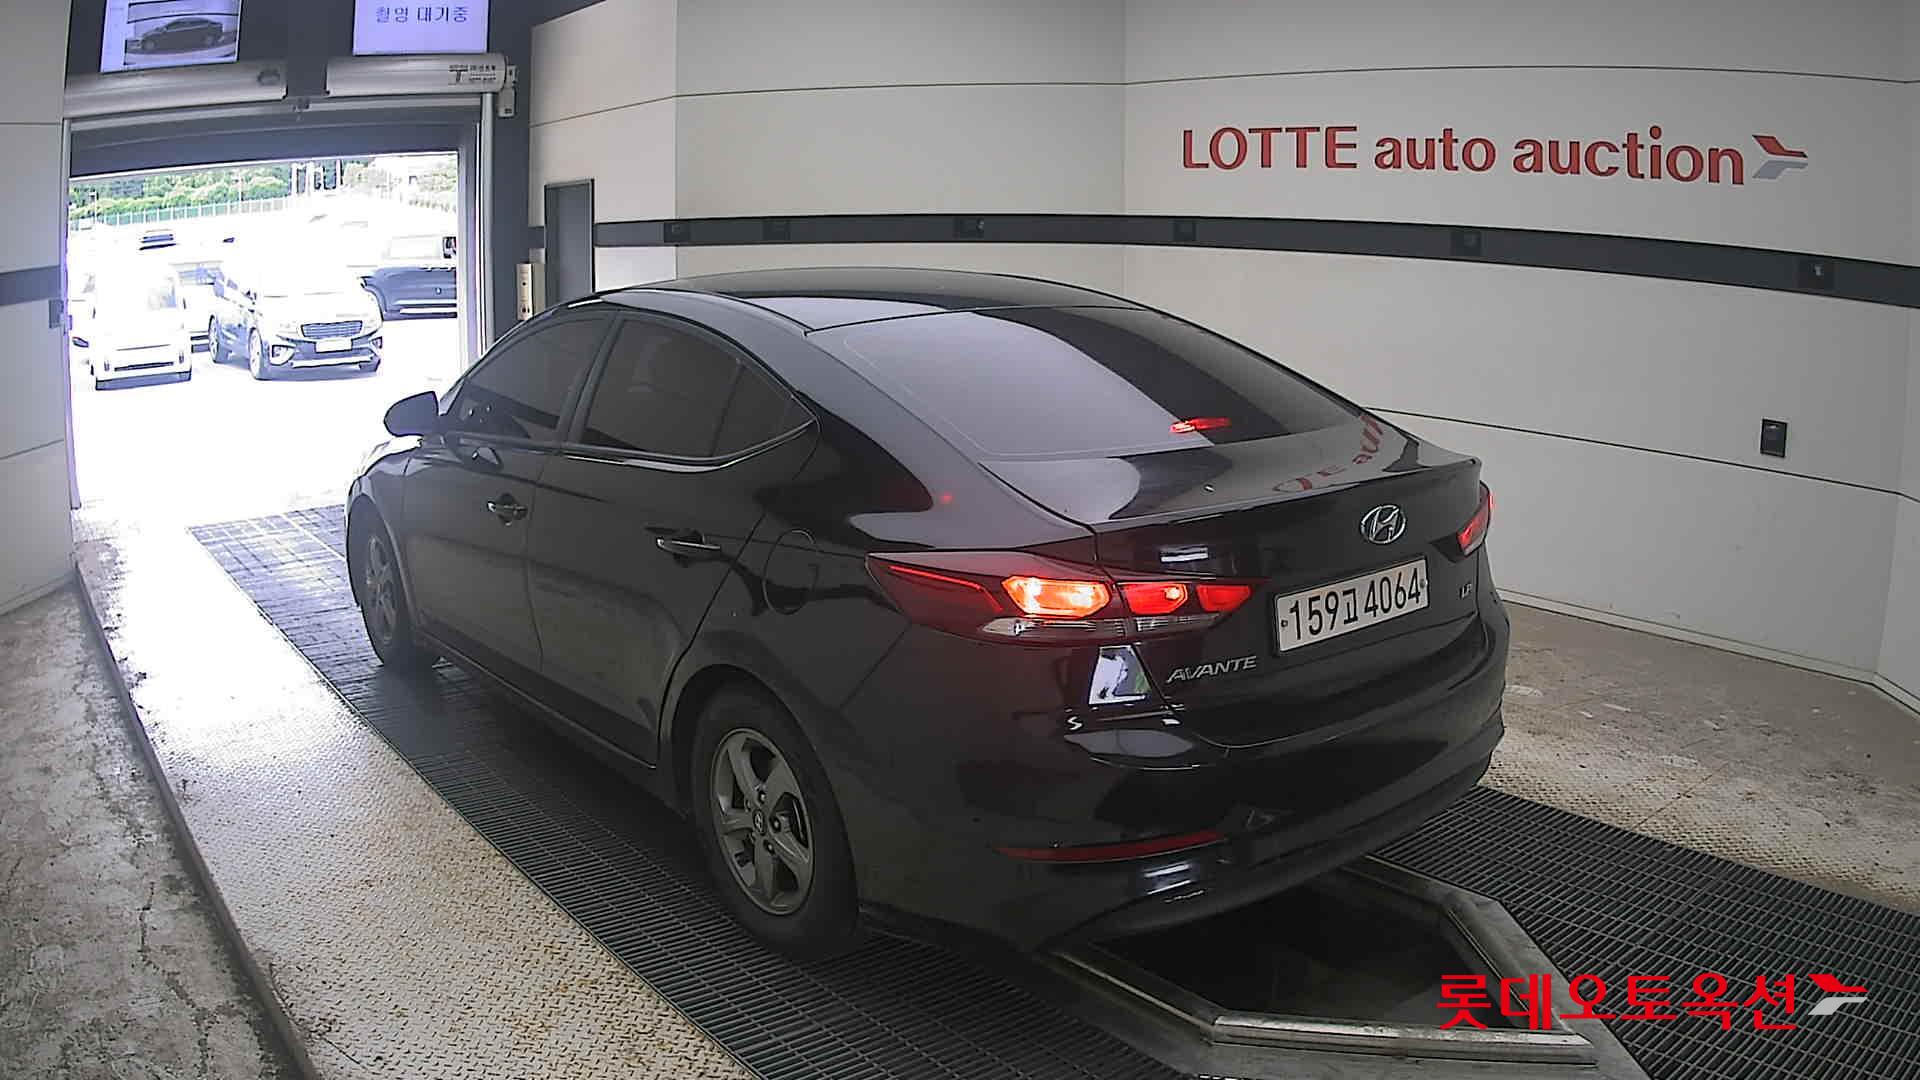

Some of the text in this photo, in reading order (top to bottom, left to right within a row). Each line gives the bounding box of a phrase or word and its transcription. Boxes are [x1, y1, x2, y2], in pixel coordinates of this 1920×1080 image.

[417, 6, 468, 23] 대기중
[1183, 126, 1745, 186] LOTTE auto auction
[1289, 567, 1422, 641] 159고 4064
[1166, 655, 1257, 684] AVANTE
